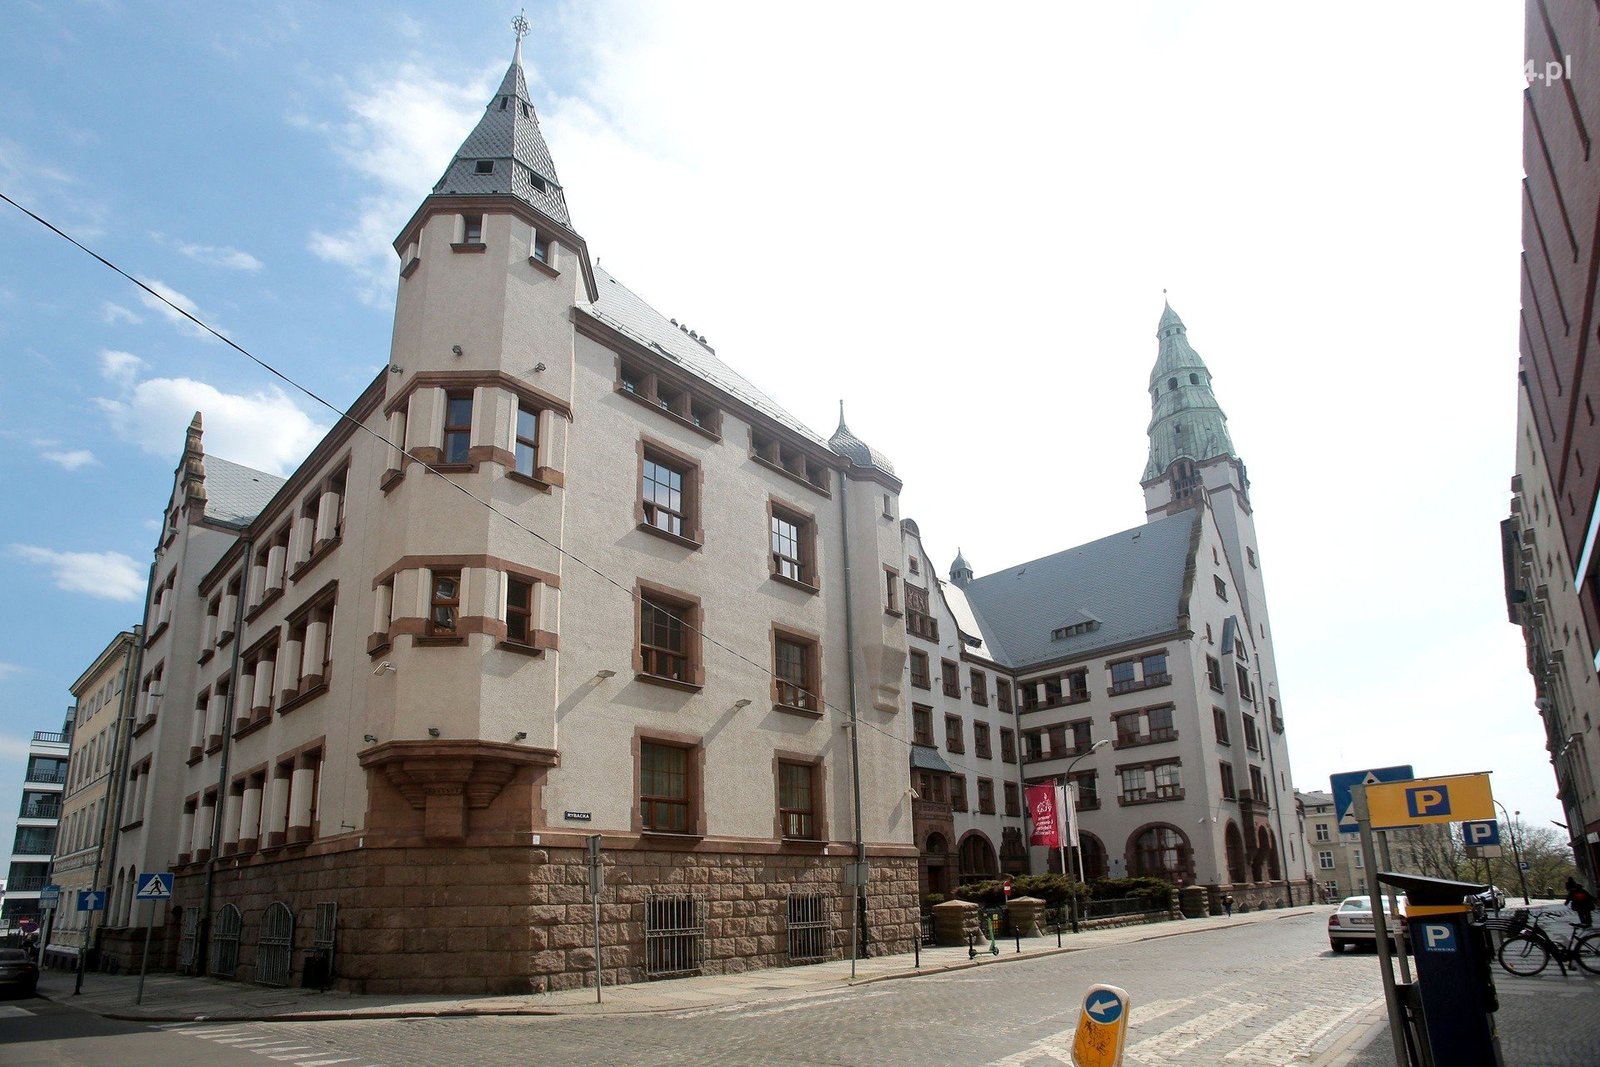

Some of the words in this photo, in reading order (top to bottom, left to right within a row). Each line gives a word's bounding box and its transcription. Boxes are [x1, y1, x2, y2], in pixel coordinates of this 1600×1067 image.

[1415, 790, 1442, 815] P
[1469, 823, 1491, 843] P
[1519, 862, 1528, 870] P
[1426, 925, 1449, 947] P
